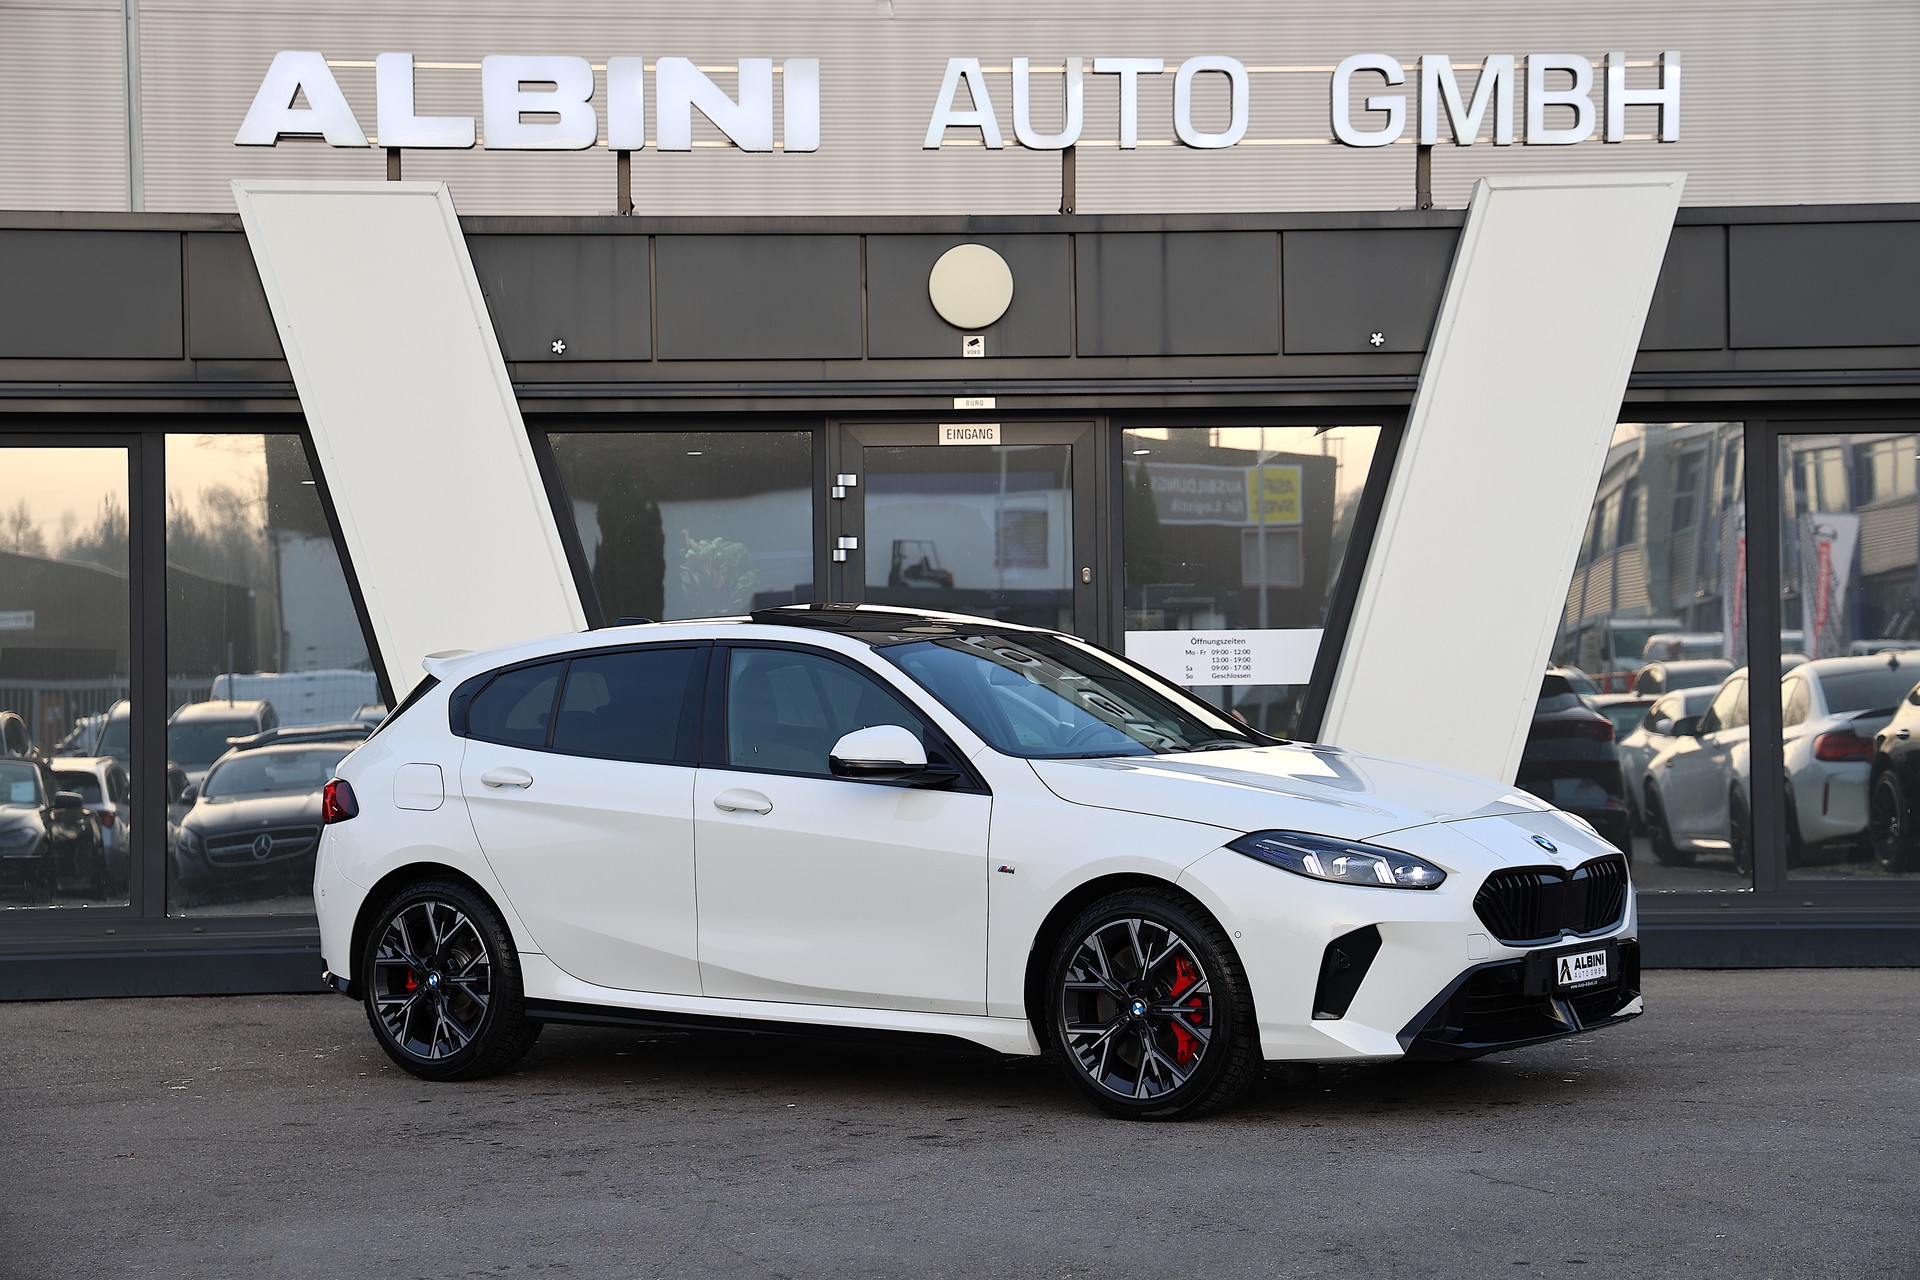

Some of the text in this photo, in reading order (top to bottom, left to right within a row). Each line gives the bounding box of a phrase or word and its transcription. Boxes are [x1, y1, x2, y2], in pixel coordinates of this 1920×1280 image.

[233, 50, 1682, 152] ALBINI AUTO GMBH
[965, 399, 984, 407] BÜRO
[946, 428, 993, 440] EINGANG
[1191, 637, 1246, 646] Öffnungszeiten
[1574, 952, 1605, 970] ALBINI
